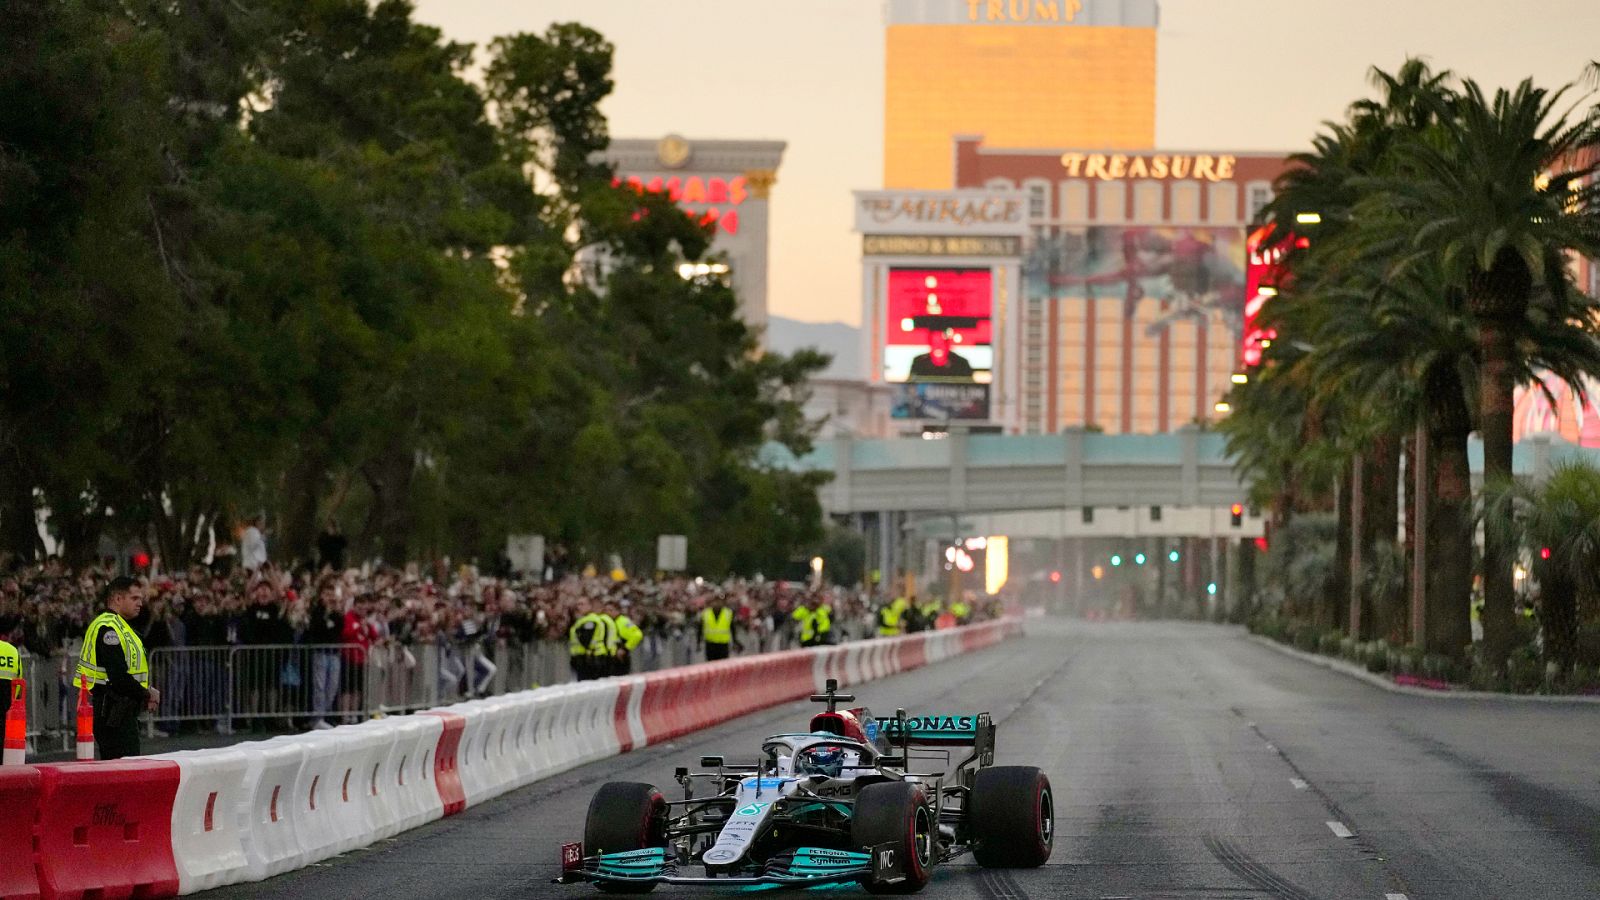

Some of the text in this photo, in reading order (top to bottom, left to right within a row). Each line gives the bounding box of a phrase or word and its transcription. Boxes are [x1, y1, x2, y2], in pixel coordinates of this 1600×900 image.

[967, 0, 1083, 22] TRUMP
[1060, 152, 1236, 182] TREASURE
[899, 196, 1024, 225] MIRAGE
[0, 655, 14, 668] CE
[809, 848, 850, 857] PETRONAS
[809, 857, 851, 866] Syntium
